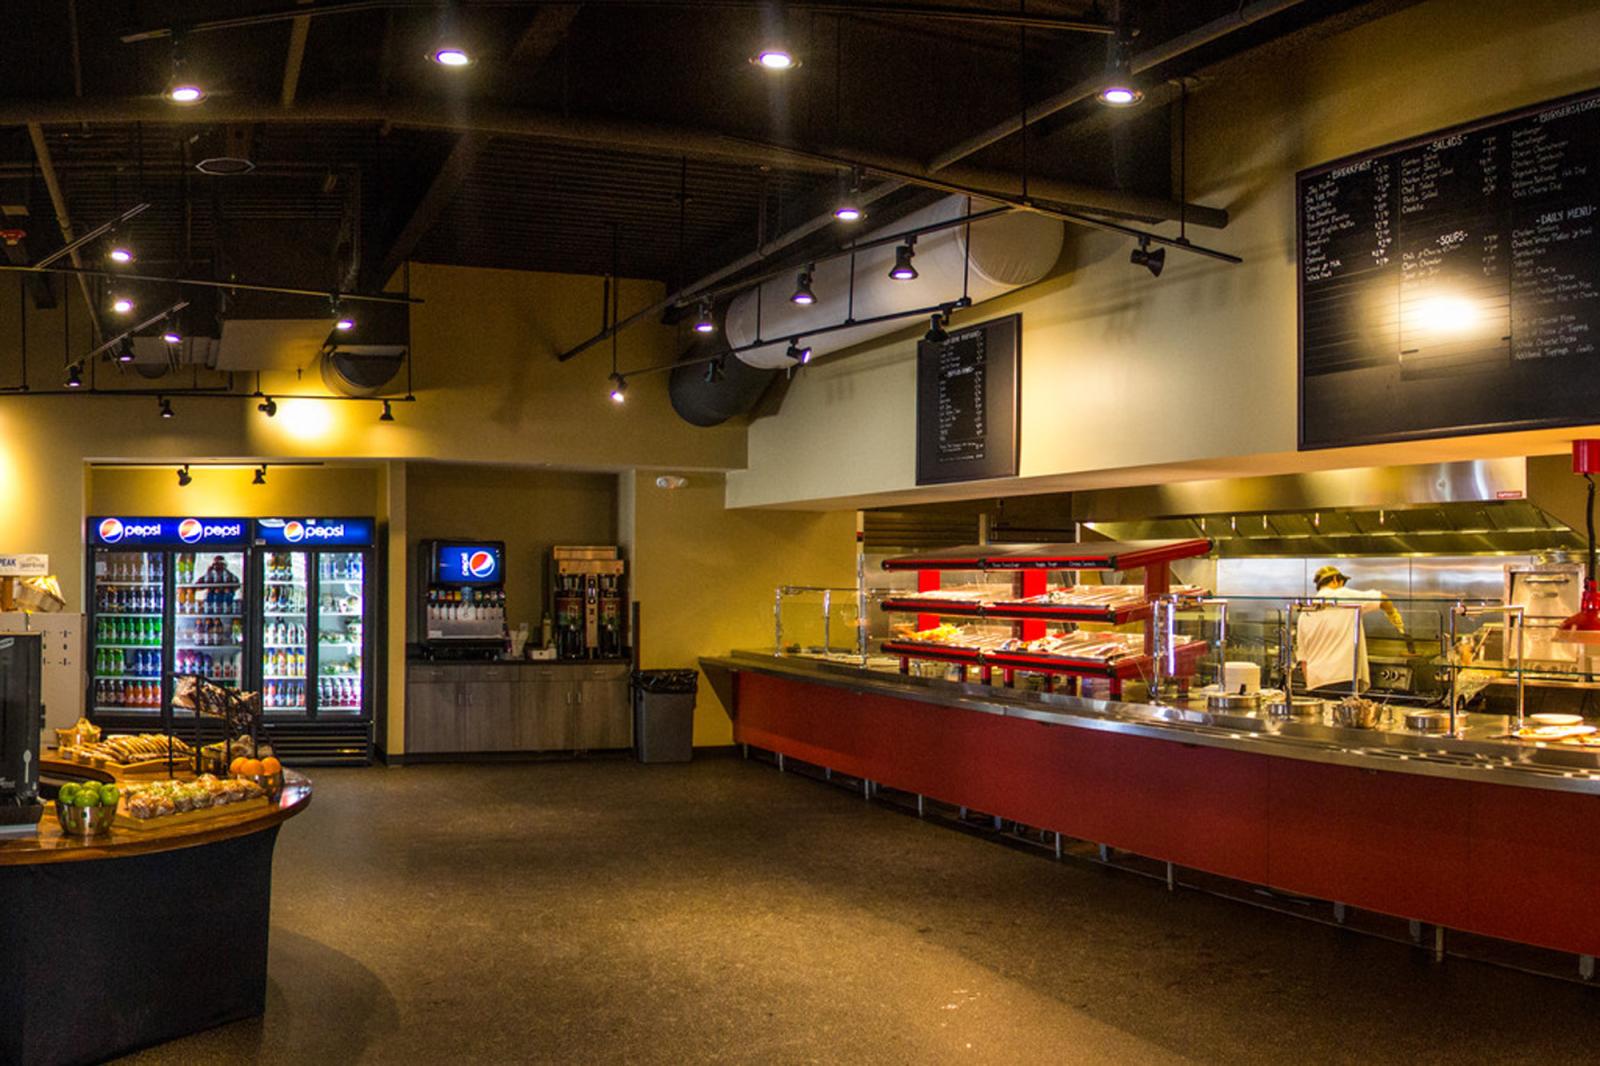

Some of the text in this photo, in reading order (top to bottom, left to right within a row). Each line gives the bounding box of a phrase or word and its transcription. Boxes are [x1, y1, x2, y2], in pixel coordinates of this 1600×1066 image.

[125, 524, 160, 537] pepsi
[204, 524, 240, 537] pepsi
[305, 524, 344, 539] pepsi
[461, 552, 470, 576] pepsi
